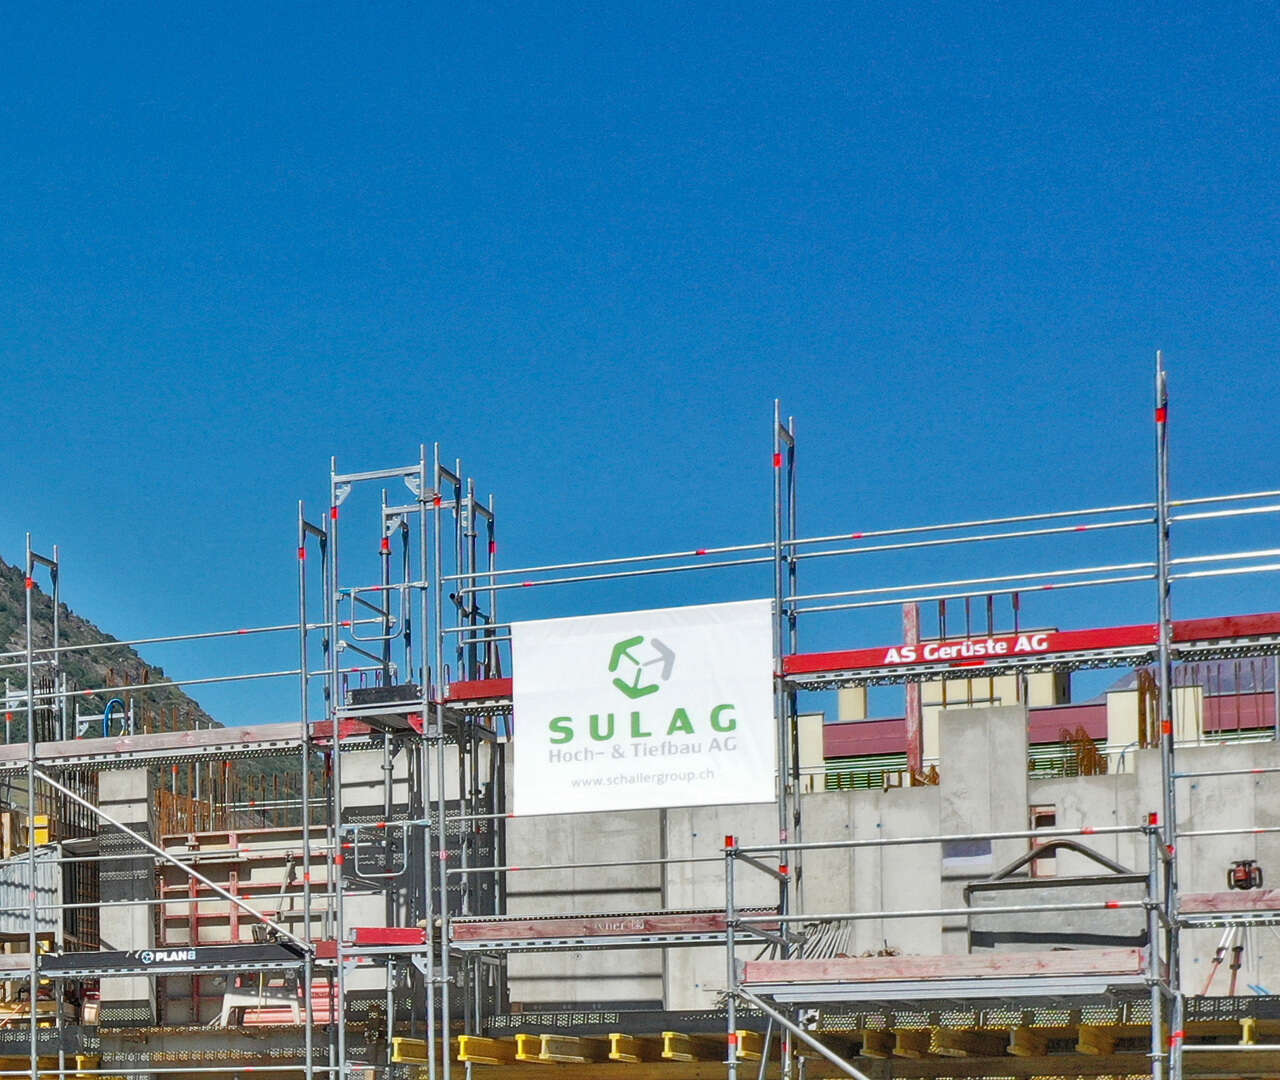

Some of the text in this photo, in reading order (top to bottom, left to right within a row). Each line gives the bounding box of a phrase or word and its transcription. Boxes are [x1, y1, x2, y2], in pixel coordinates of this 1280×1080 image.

[884, 634, 1048, 664] AS Gerüste AG
[548, 704, 737, 744] SULAG
[548, 736, 737, 763] Hoch- & Tiefbau AG
